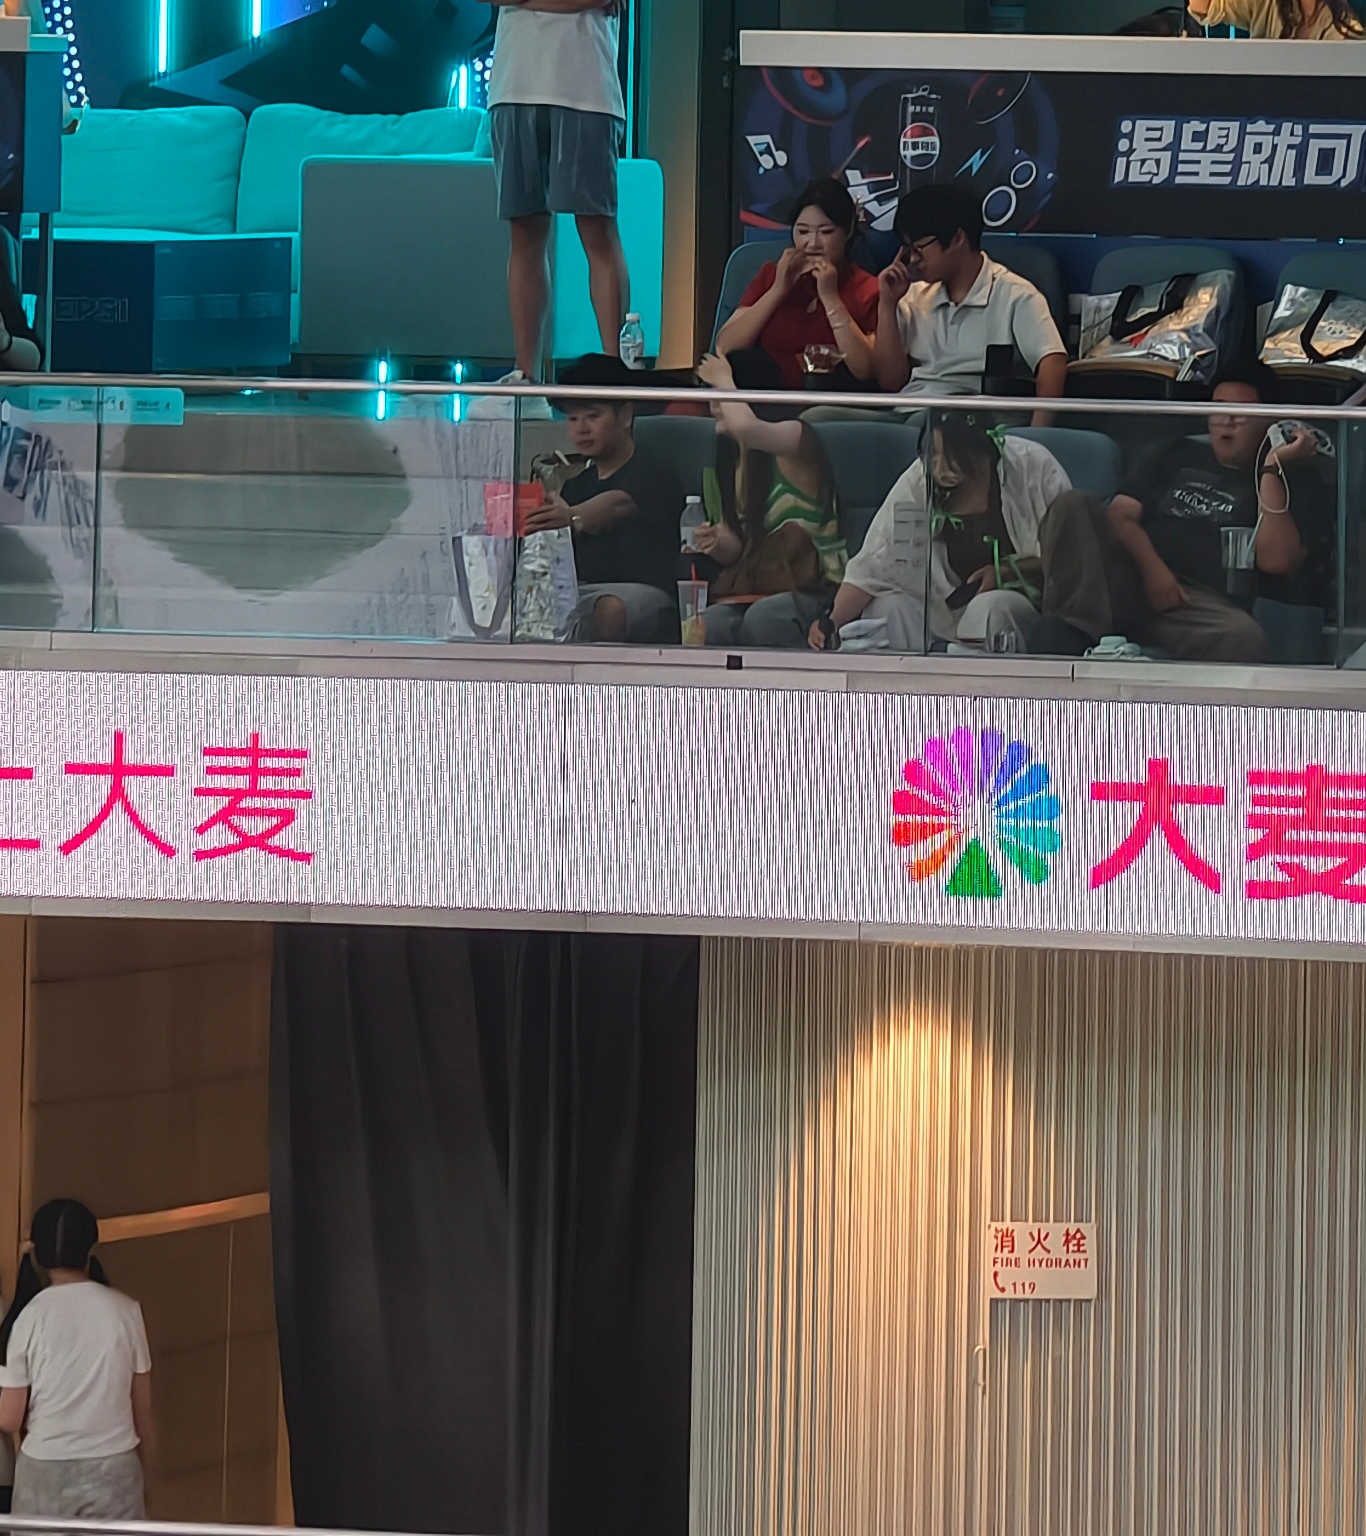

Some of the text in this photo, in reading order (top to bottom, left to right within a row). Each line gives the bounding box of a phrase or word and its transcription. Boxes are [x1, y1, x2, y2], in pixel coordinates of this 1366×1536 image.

[993, 1226, 1087, 1254] 消火栓
[992, 1256, 1089, 1269] FIRE HYDRANT
[1011, 1281, 1037, 1295] 119
